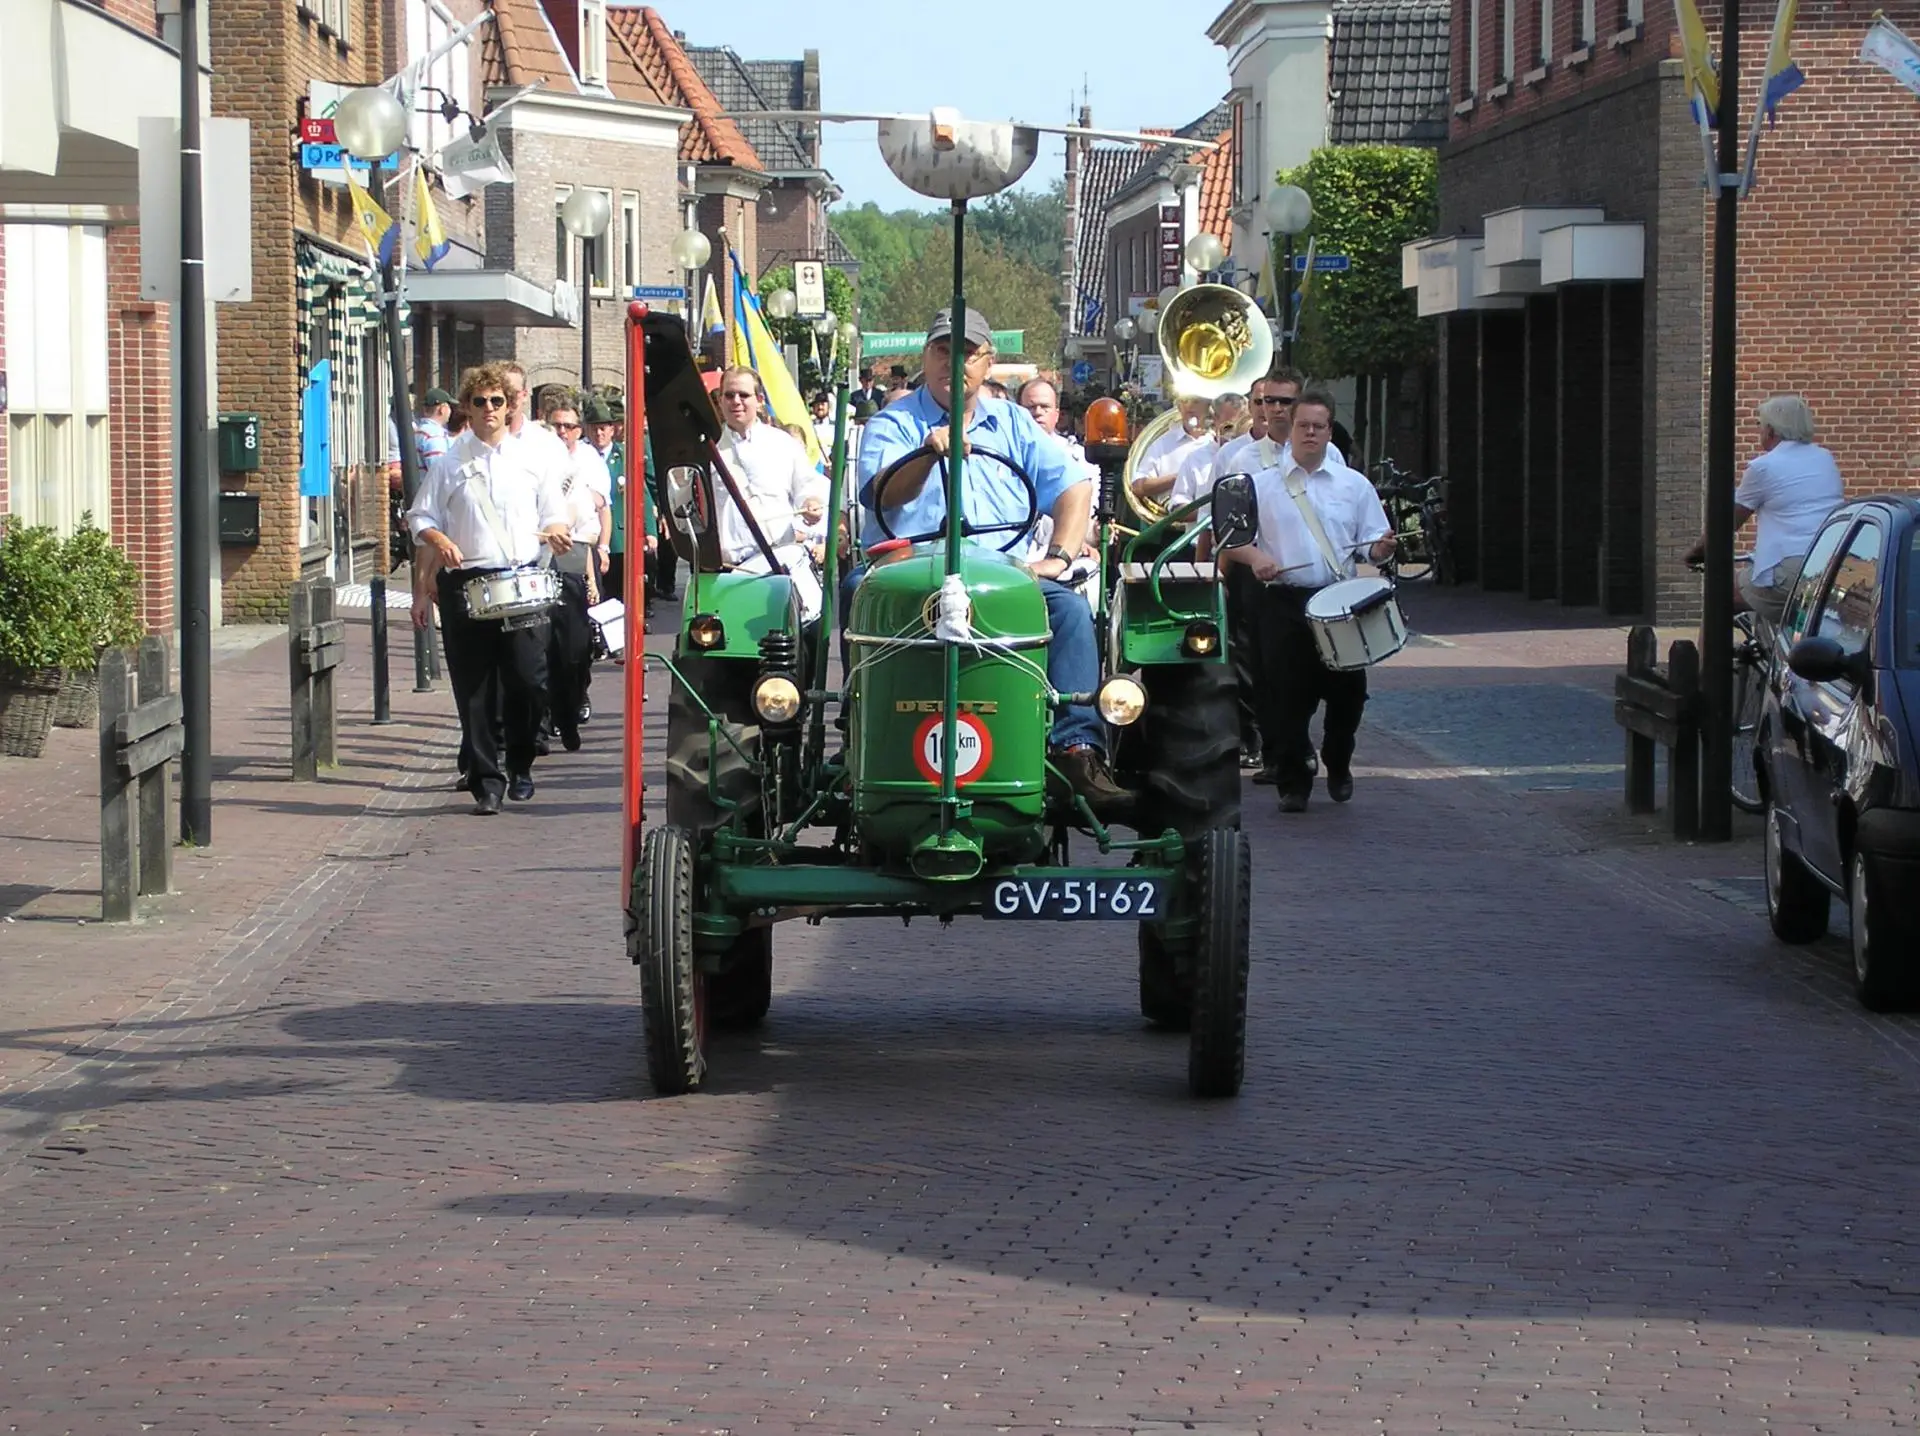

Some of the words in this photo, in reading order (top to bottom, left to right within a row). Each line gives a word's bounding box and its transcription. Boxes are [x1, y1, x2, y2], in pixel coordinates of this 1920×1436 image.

[245, 423, 256, 449] 48
[930, 732, 959, 764] 1
[958, 732, 976, 748] km
[994, 881, 1155, 914] GV-51-62
